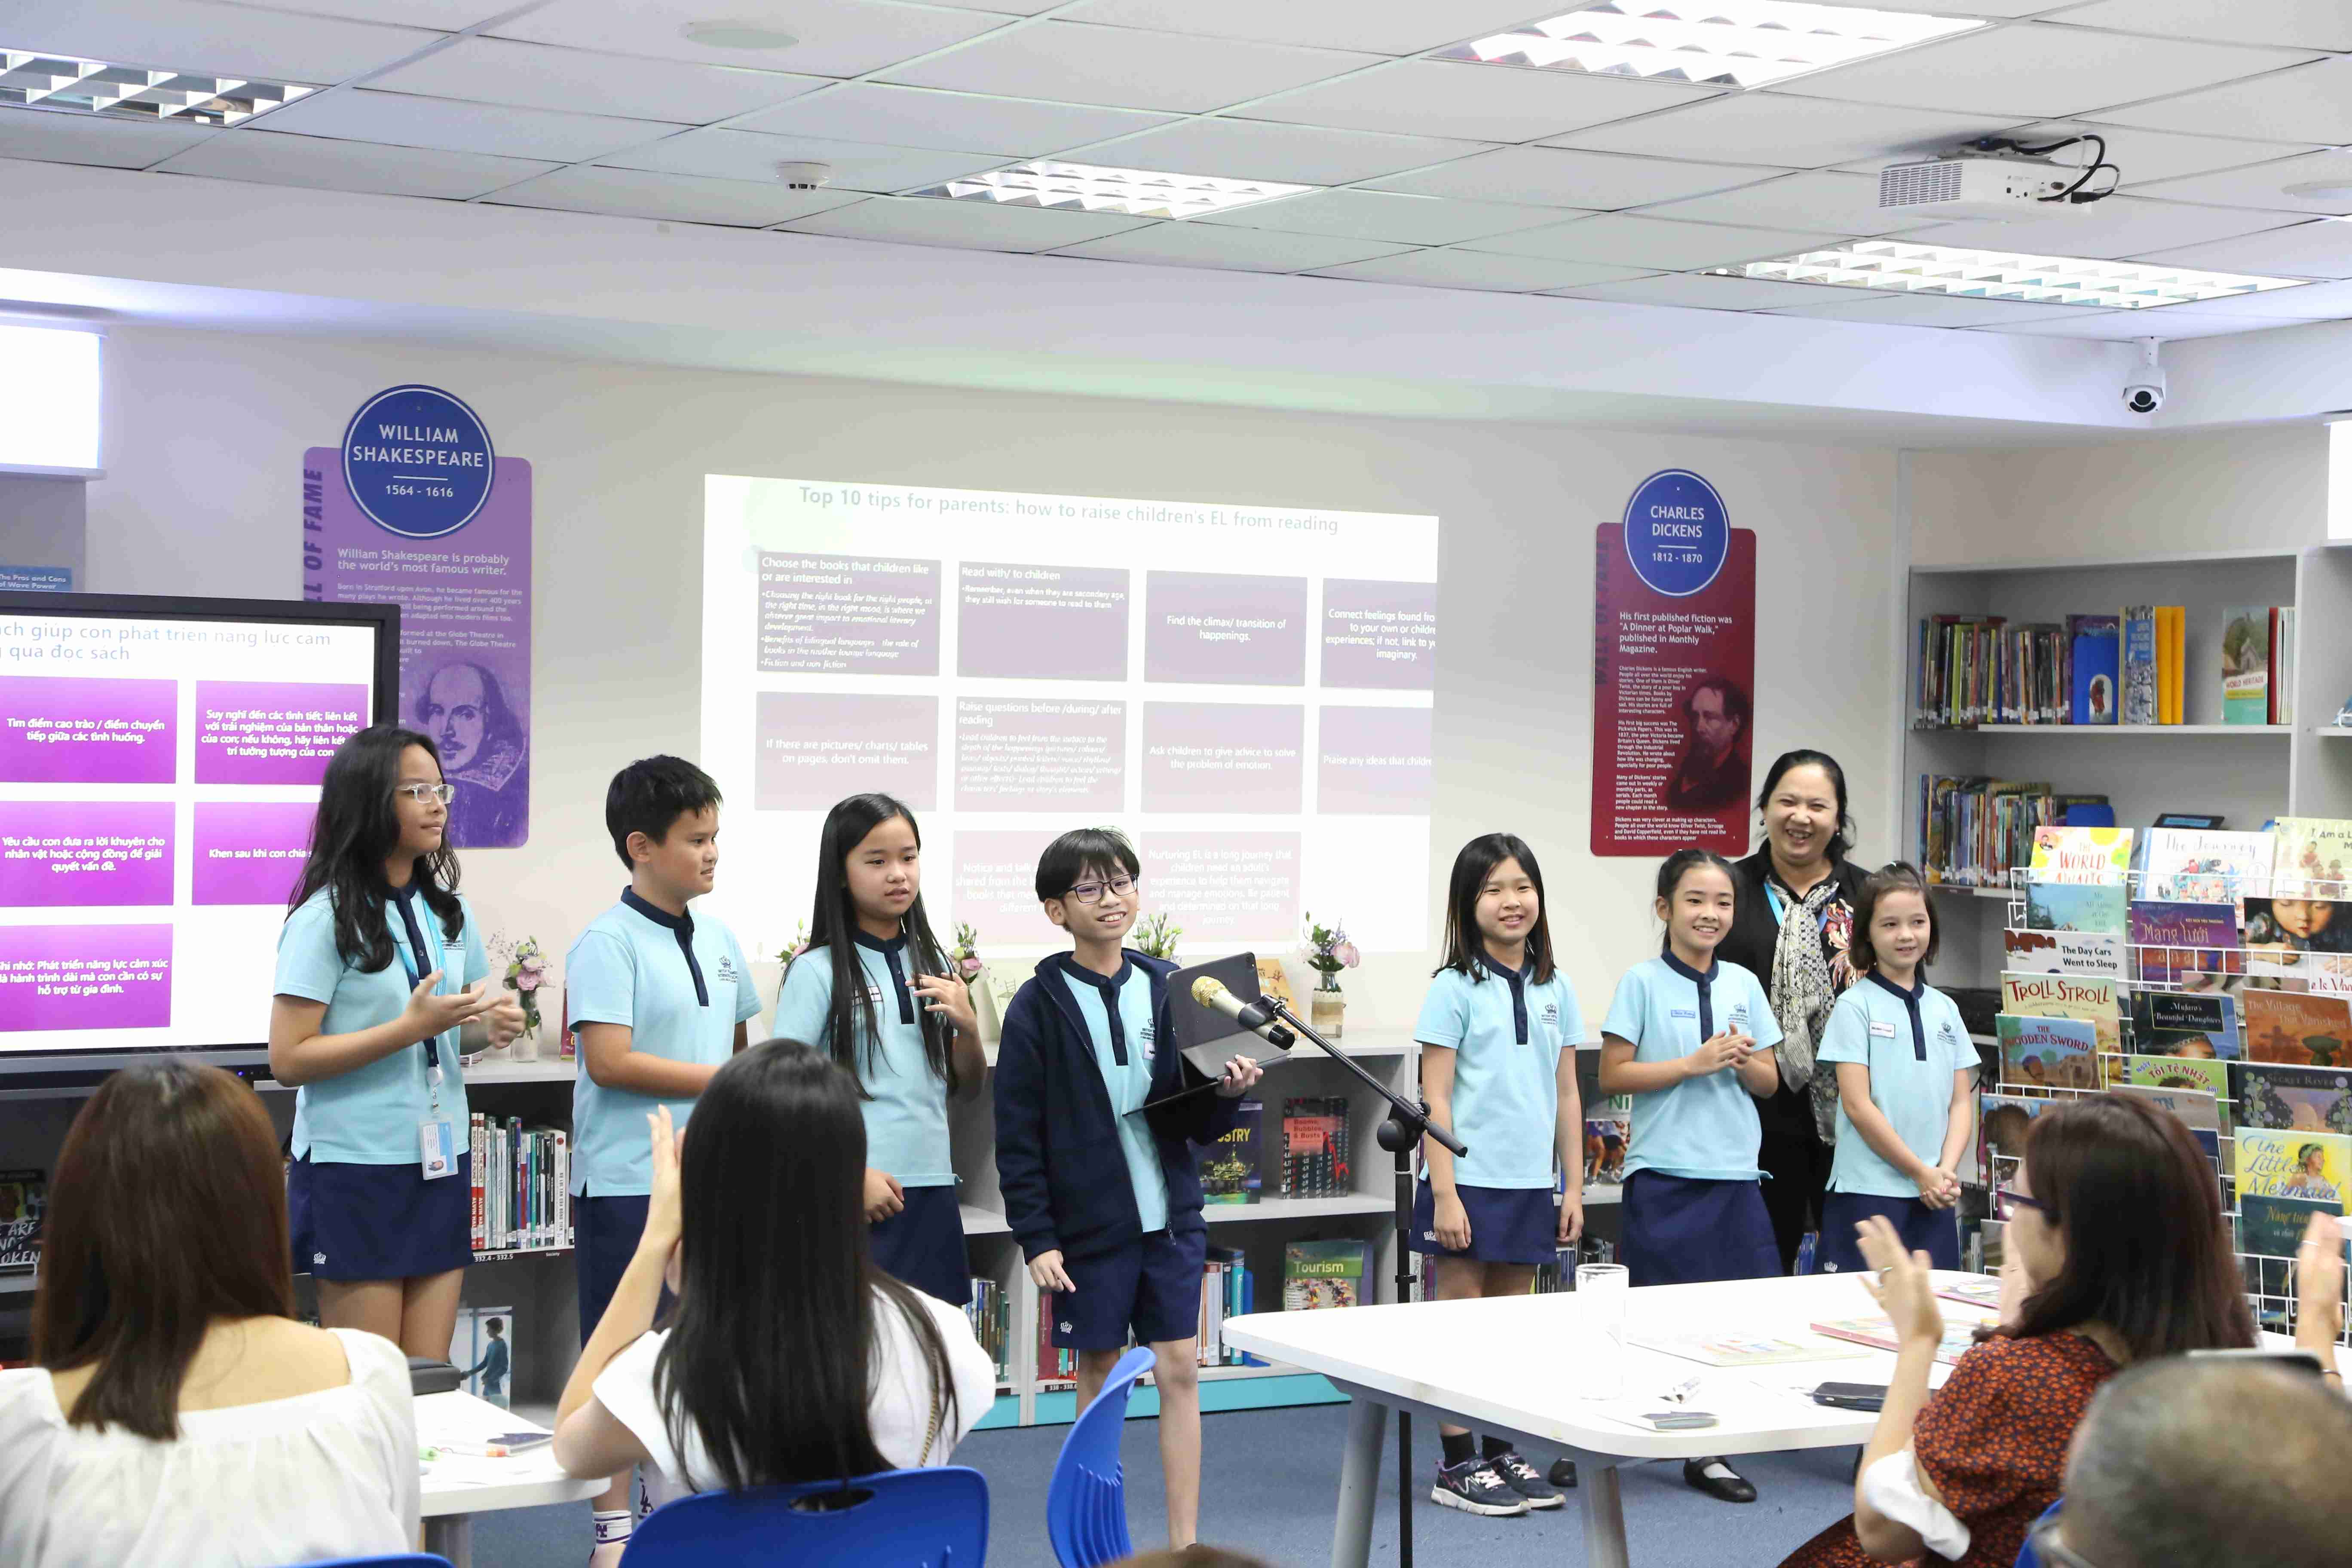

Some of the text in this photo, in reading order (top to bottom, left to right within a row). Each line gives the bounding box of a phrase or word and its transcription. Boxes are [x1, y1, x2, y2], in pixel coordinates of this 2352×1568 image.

[379, 424, 458, 443] WILLIAM
[353, 446, 483, 467] SHAKESPEARE
[386, 485, 453, 497] 1564 1616
[303, 468, 323, 533] FAME
[799, 486, 1338, 536] Top 10 tips for parents: how to raise children's EL from reading
[1651, 505, 1704, 520] CHARLES
[1652, 524, 1703, 538] DICKENS
[303, 541, 323, 570] OF
[337, 548, 509, 566] William Shakespeare is probably
[1653, 552, 1702, 563] 1812 1870
[338, 560, 506, 575] the world's most famous writer.
[762, 557, 929, 574] Choose the books that children like
[962, 567, 1060, 580] Read with/ to children
[1167, 615, 1286, 630] Find the climax/ transition of
[1620, 612, 1632, 620] His
[1634, 612, 1650, 621] first
[1652, 613, 1689, 623] published
[1691, 614, 1716, 623] fiction
[80, 628, 111, 638] con
[1630, 623, 1656, 631] Dinner
[1668, 624, 1692, 634] Poplar
[1200, 629, 1251, 643] happenings.
[1619, 634, 1699, 645] published in Monthly
[9, 647, 43, 661] qua
[1620, 644, 1657, 654] Magazine.
[959, 701, 983, 711] Raise
[985, 702, 1029, 714] questions
[1031, 702, 1060, 713] before
[1101, 704, 1121, 715] after
[959, 715, 993, 727] reading
[766, 738, 774, 748] If
[775, 739, 801, 749] there
[821, 740, 863, 751] pictures/
[900, 741, 928, 751] tables
[1149, 746, 1165, 755] Ask
[1167, 746, 1201, 756] children
[1204, 748, 1213, 756] to
[1215, 746, 1233, 759] give
[1235, 747, 1262, 757] advice
[1274, 748, 1296, 757] solve
[2319, 830, 2335, 839] Am
[209, 848, 233, 858] Khen
[253, 848, 267, 858] khi
[288, 848, 306, 858] chia
[2060, 850, 2106, 870] WORLD
[2062, 946, 2111, 957] The Day Cars
[2063, 958, 2084, 967] Went
[2096, 959, 2117, 970] Sleep
[2006, 980, 2110, 1004] TROLL STROLL
[2248, 998, 2301, 1012] The Village
[2049, 1034, 2089, 1052] SWORD
[8, 1221, 36, 1236] ARE
[1293, 1260, 1344, 1273] Tourism
